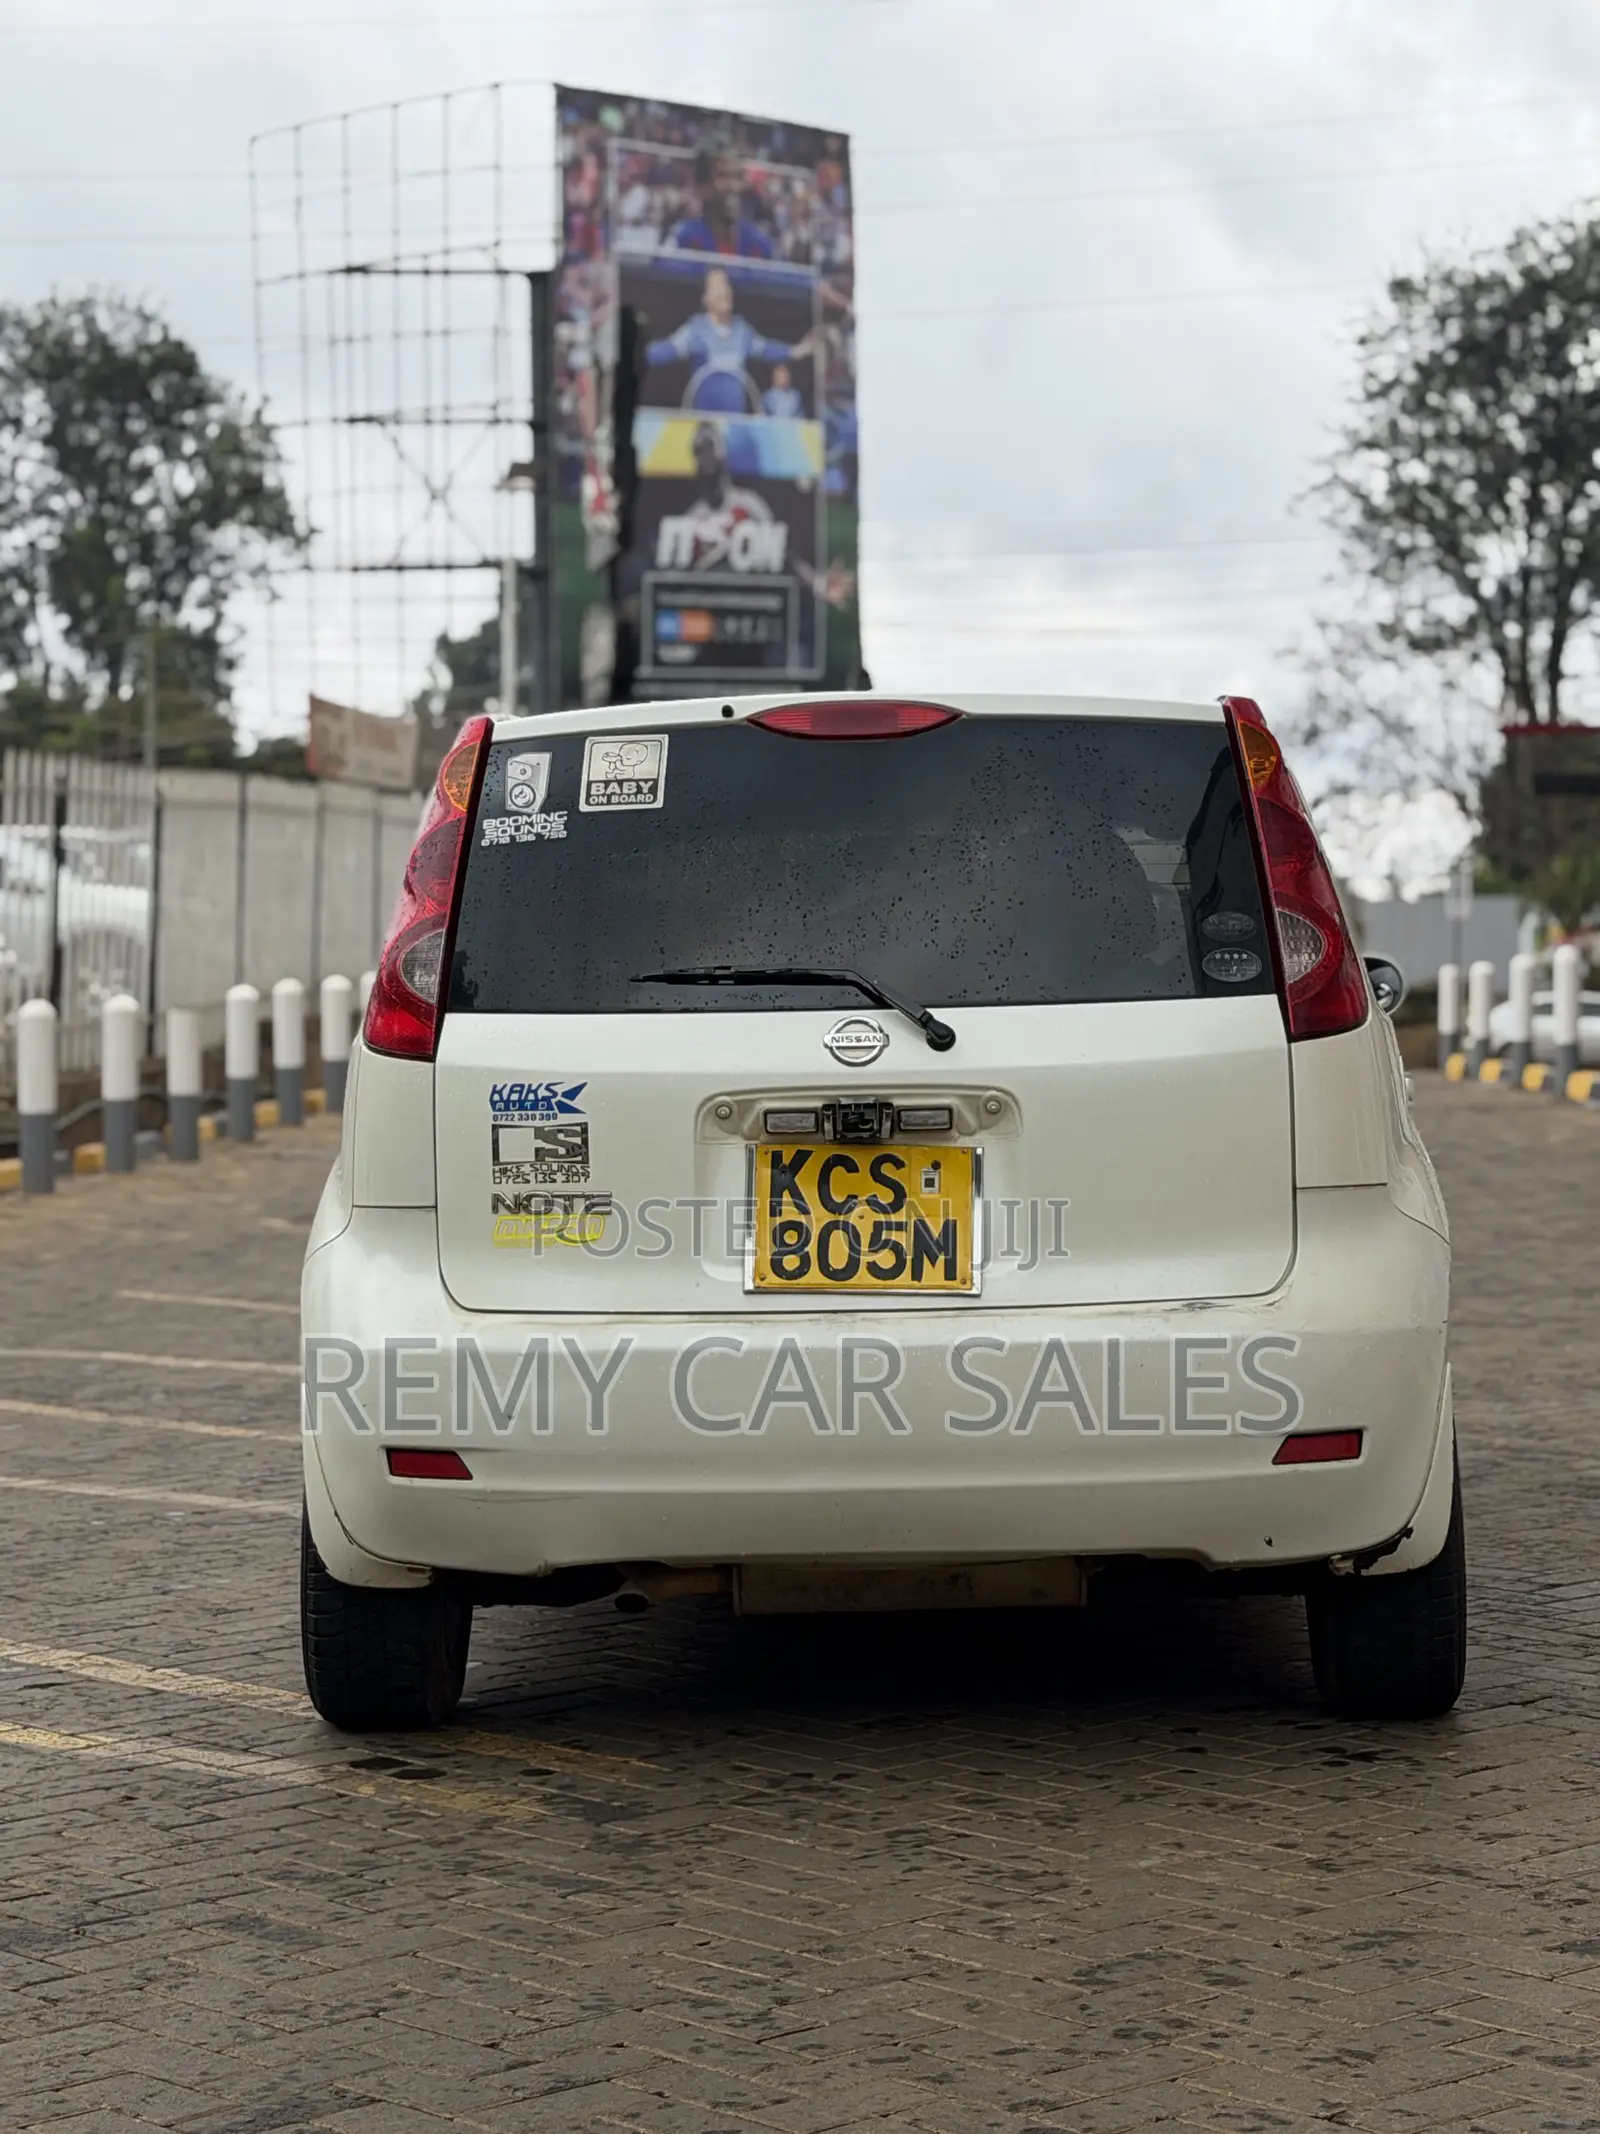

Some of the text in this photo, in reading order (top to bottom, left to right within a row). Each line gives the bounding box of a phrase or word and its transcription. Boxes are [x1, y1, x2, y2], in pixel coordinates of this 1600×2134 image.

[590, 781, 654, 795] BABY
[589, 794, 654, 804] ON BOARD
[482, 811, 568, 829] BOOMING
[484, 820, 566, 839] SOUNDS
[831, 1035, 881, 1044] NISSAN
[489, 1081, 565, 1101] KAKS
[495, 1101, 548, 1110] AUTO
[492, 1113, 515, 1122] 0722
[529, 1163, 590, 1177] SOUNDS
[769, 1149, 908, 1218] KCS
[491, 1189, 613, 1215] NOTE
[769, 1219, 958, 1283] 805M
